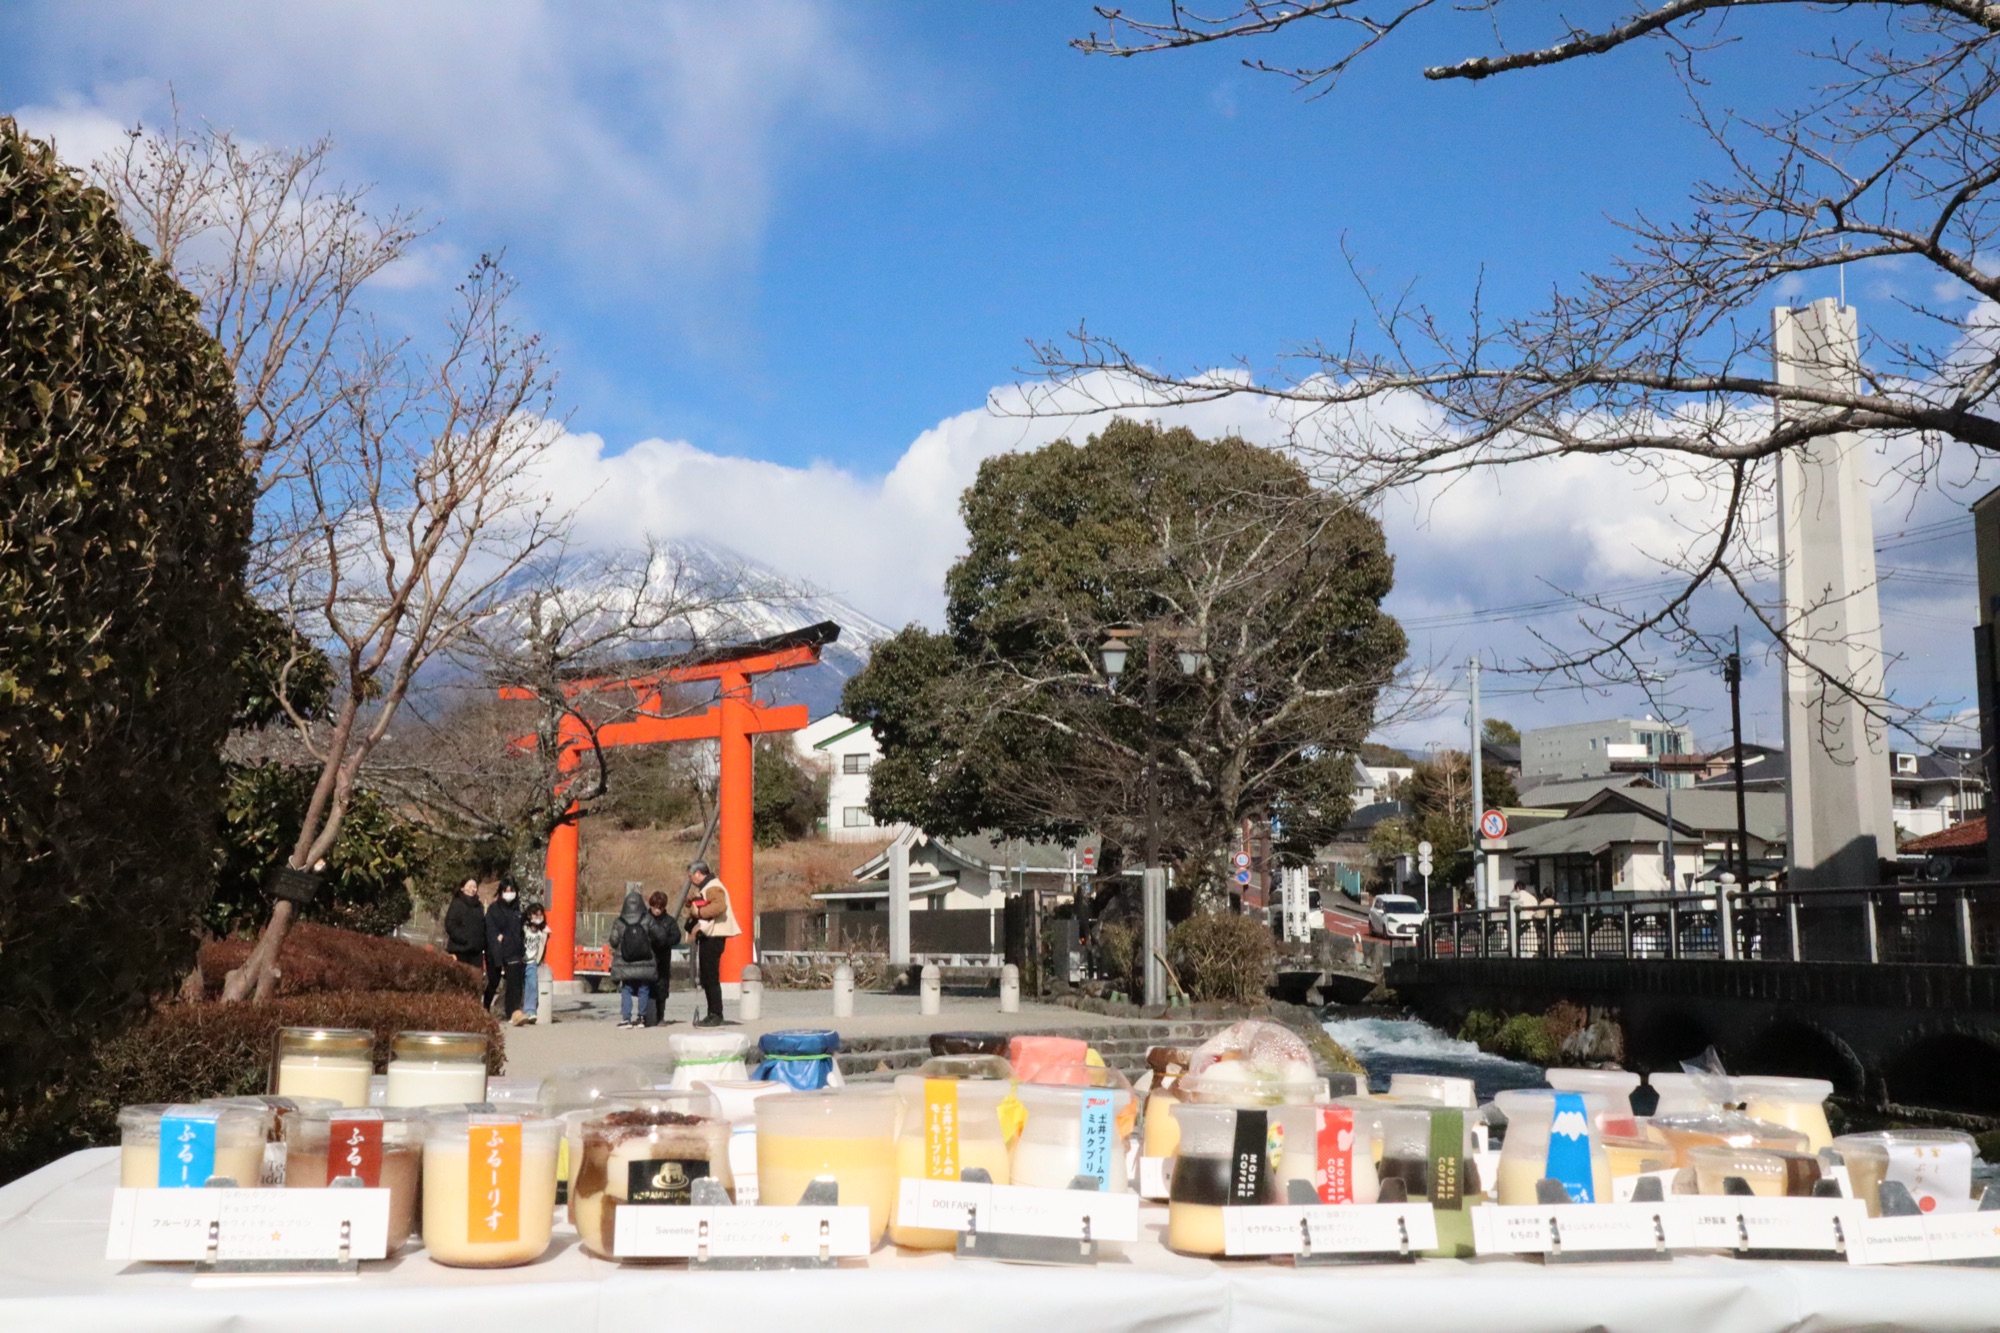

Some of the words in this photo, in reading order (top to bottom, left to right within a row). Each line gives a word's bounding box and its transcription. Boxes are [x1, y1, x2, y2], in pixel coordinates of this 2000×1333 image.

[177, 1123, 197, 1188] ふるー
[930, 1103, 943, 1176] モーモープリン
[484, 1129, 504, 1231] ふるーりす
[1237, 1153, 1249, 1197] COFFEE
[1327, 1157, 1336, 1201] COFFEE
[1437, 1156, 1446, 1199] COFFEE
[151, 1218, 202, 1228] フルーリス
[931, 1199, 950, 1209] DOI
[655, 1225, 695, 1236] Sweetee
[1866, 1235, 1893, 1245] Ohana
[1893, 1234, 1924, 1244] kitchen
